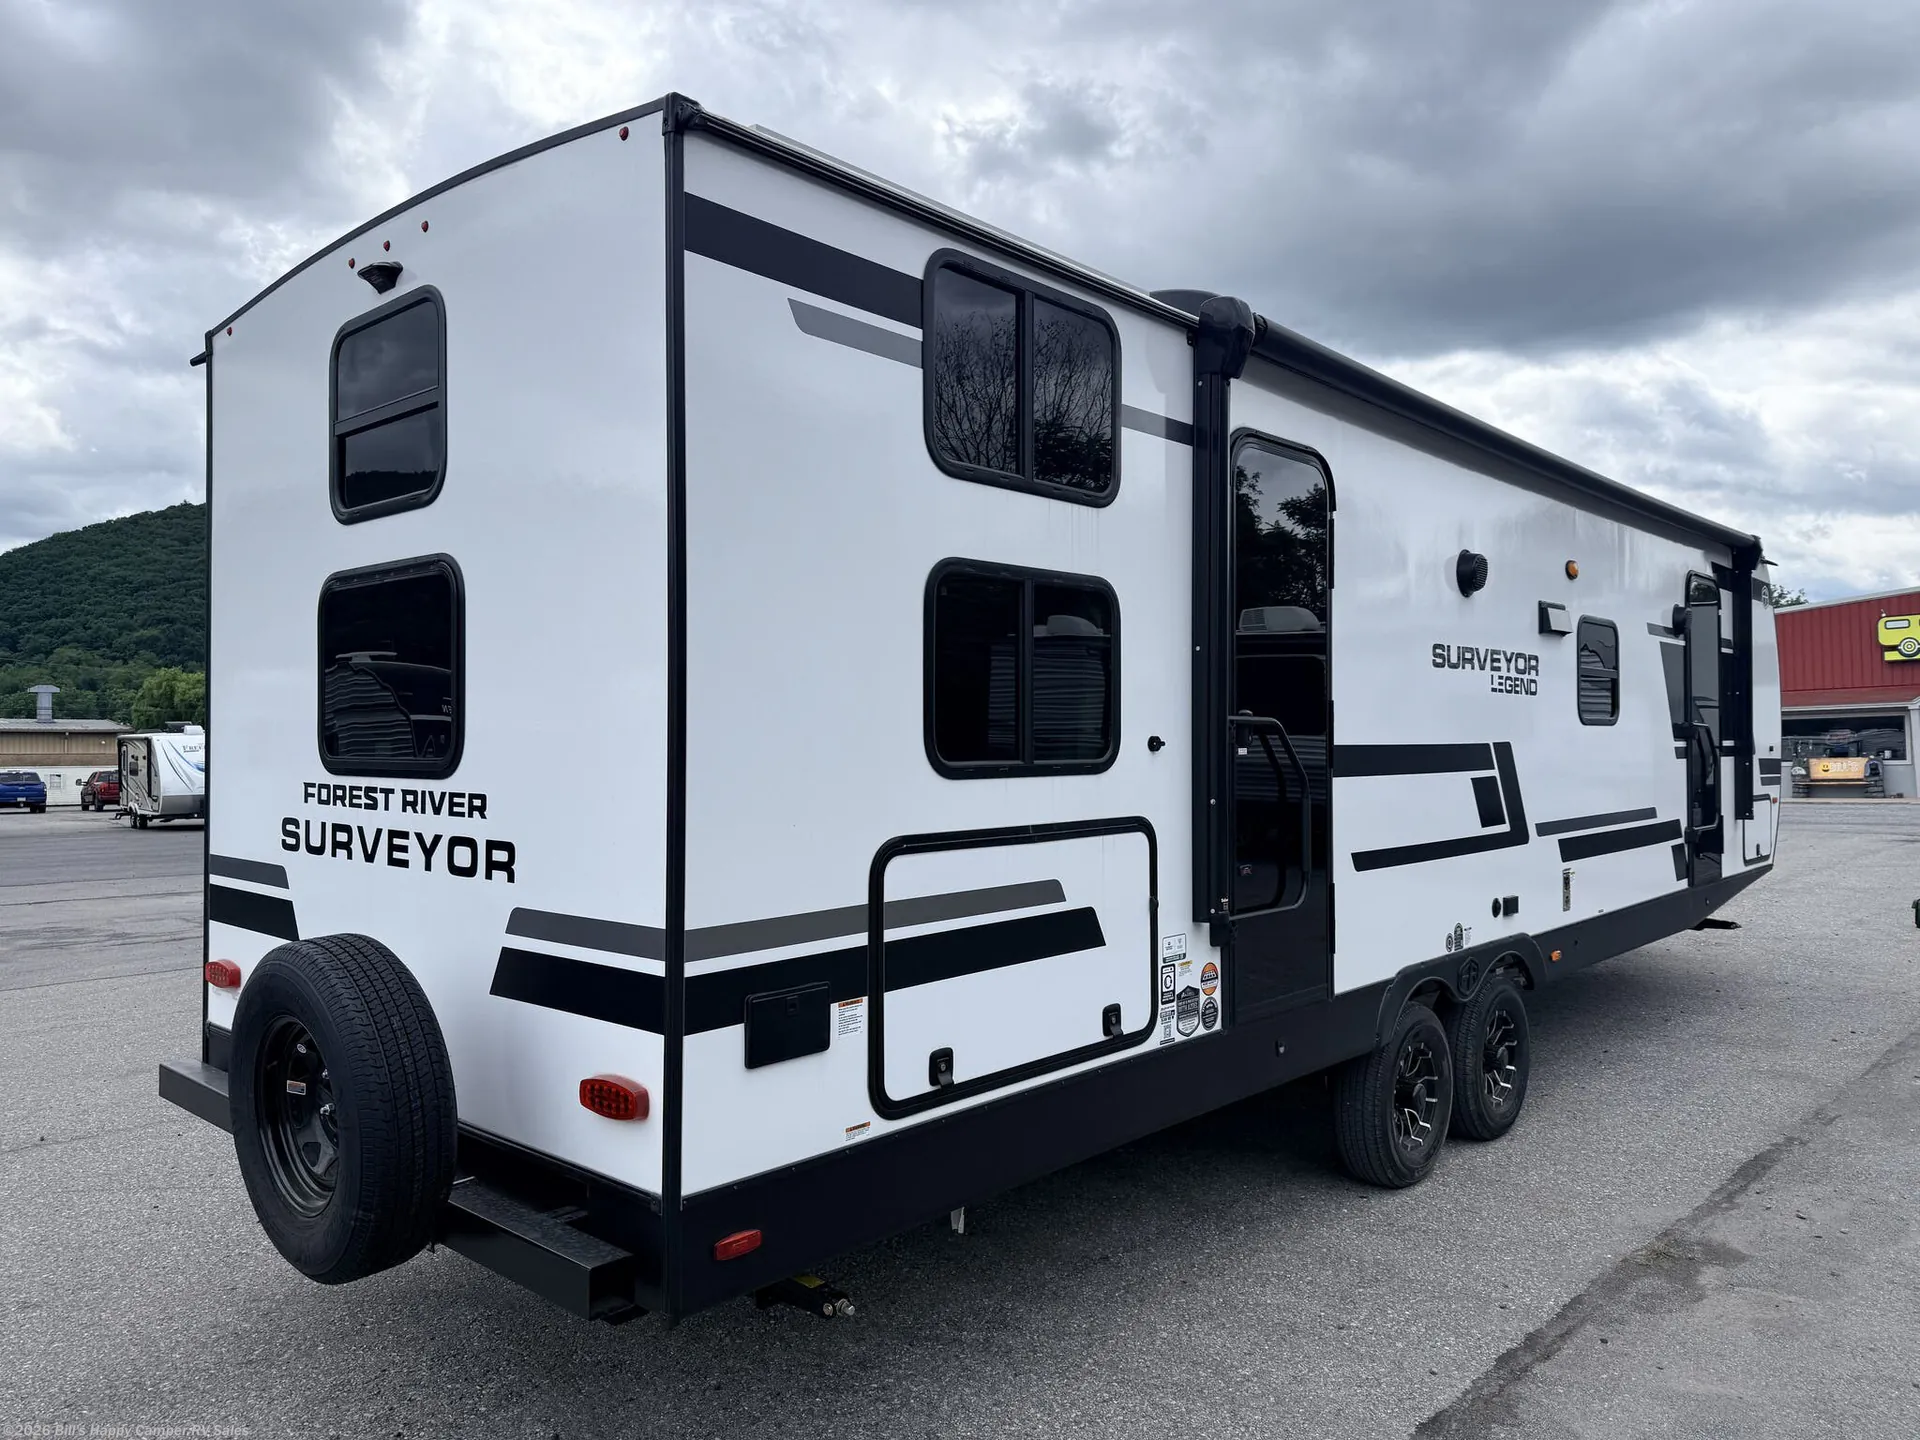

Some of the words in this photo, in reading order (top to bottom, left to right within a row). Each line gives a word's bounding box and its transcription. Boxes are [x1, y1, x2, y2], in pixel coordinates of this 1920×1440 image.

[1432, 643, 1539, 676] SURVEYOR
[1490, 674, 1538, 696] LEGEND
[303, 782, 395, 812] FOREST
[401, 789, 488, 820] RIVER
[281, 817, 516, 884] SURVEYOR
